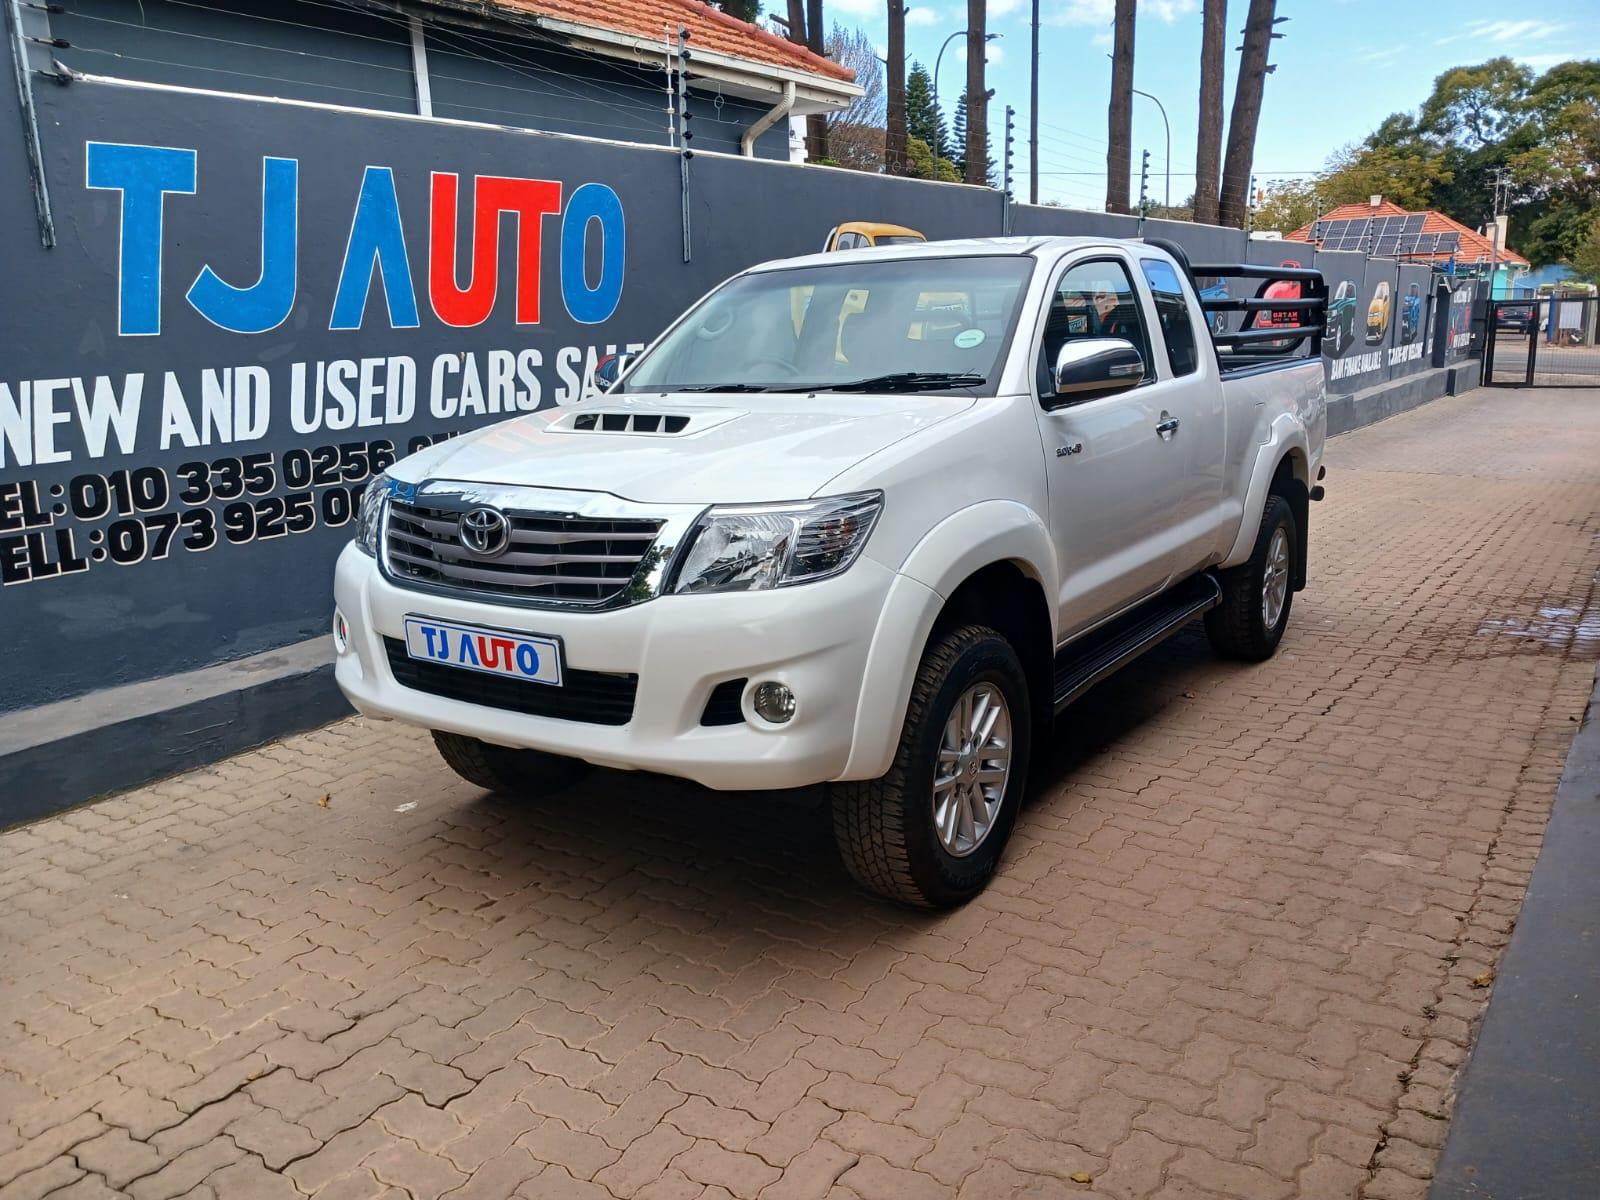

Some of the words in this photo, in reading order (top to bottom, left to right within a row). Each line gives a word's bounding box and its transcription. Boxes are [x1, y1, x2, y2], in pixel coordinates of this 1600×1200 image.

[86, 141, 298, 336] TJ
[329, 166, 625, 330] AUTO
[0, 373, 144, 468] NEW
[160, 365, 270, 450] AND
[291, 355, 417, 434] USED
[430, 349, 543, 419] CARS
[176, 457, 277, 506] 335
[282, 440, 396, 490] 0256
[223, 492, 316, 545] 925
[421, 626, 449, 659] TJ
[459, 634, 540, 676] AUTO
